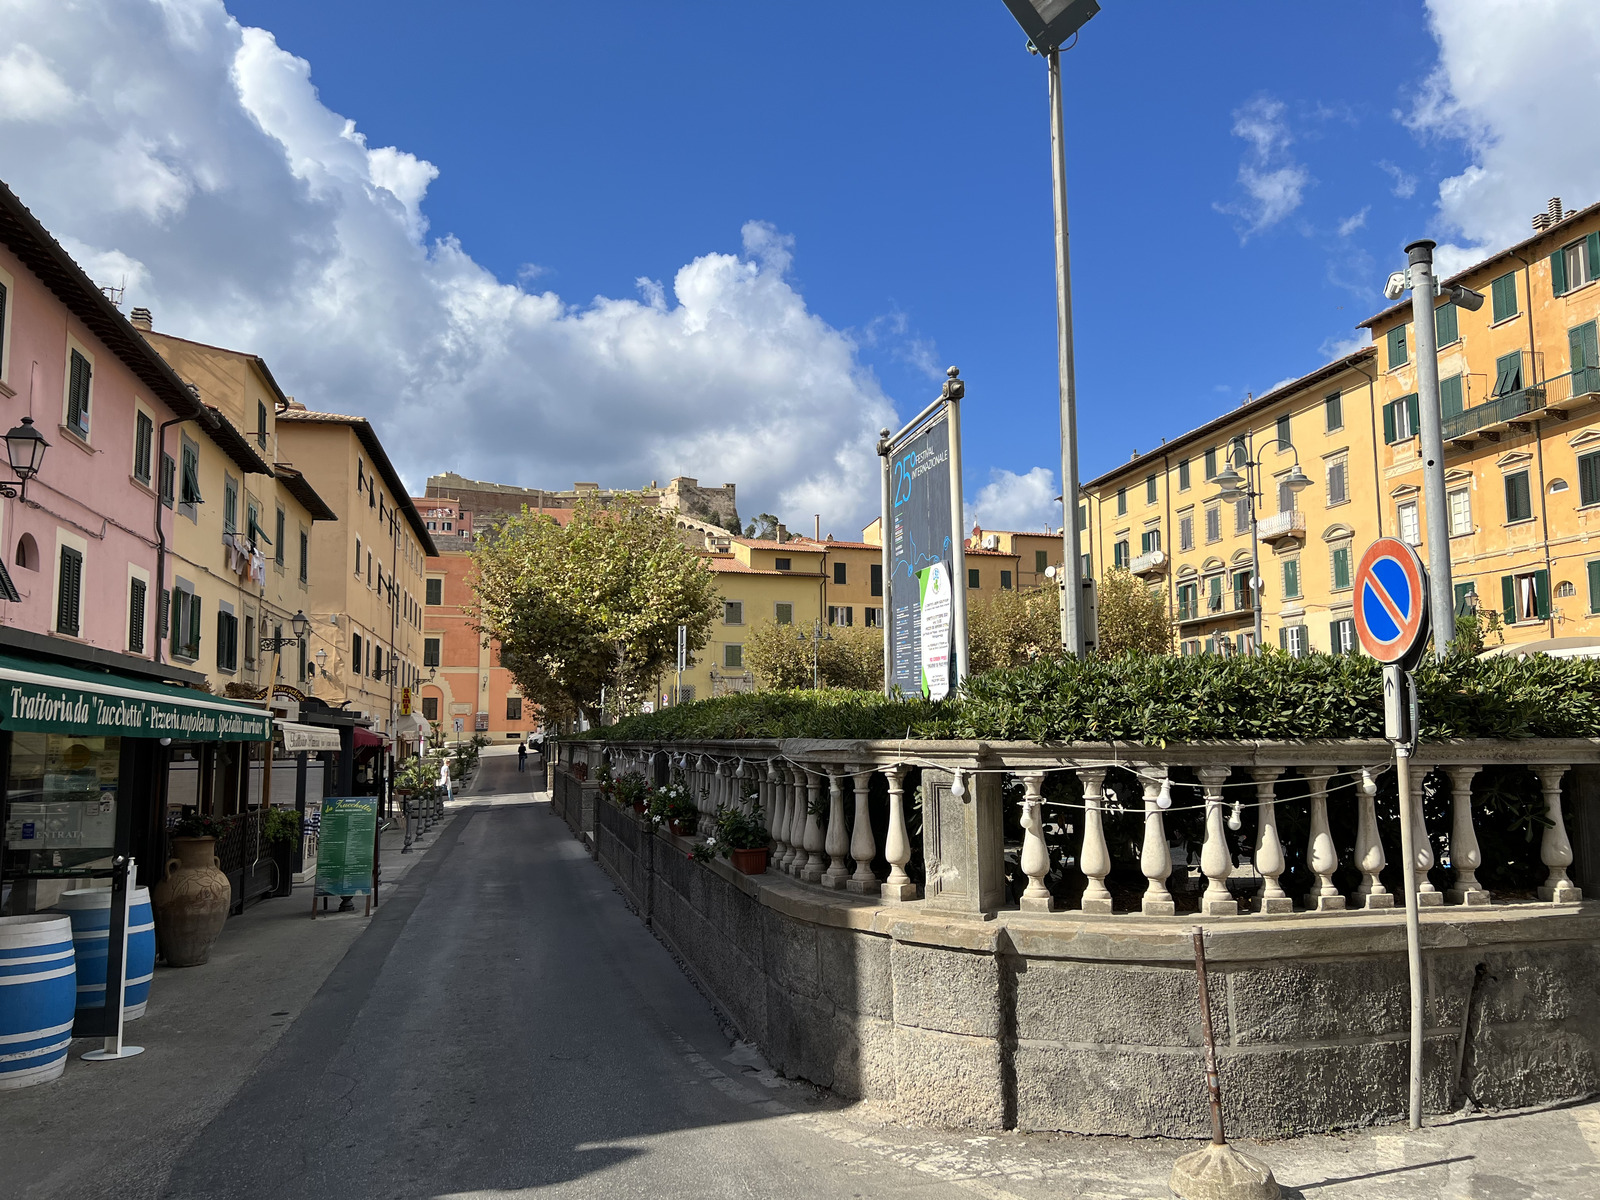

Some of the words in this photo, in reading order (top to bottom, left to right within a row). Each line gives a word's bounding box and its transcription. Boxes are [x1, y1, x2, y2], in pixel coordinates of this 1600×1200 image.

[894, 450, 916, 508] 25°
[915, 446, 935, 465] FESTIVAL
[911, 449, 948, 480] INTERNAZIONALE
[11, 685, 73, 722] Trattoria
[73, 694, 89, 724] da
[36, 830, 85, 839] ENTRATA
